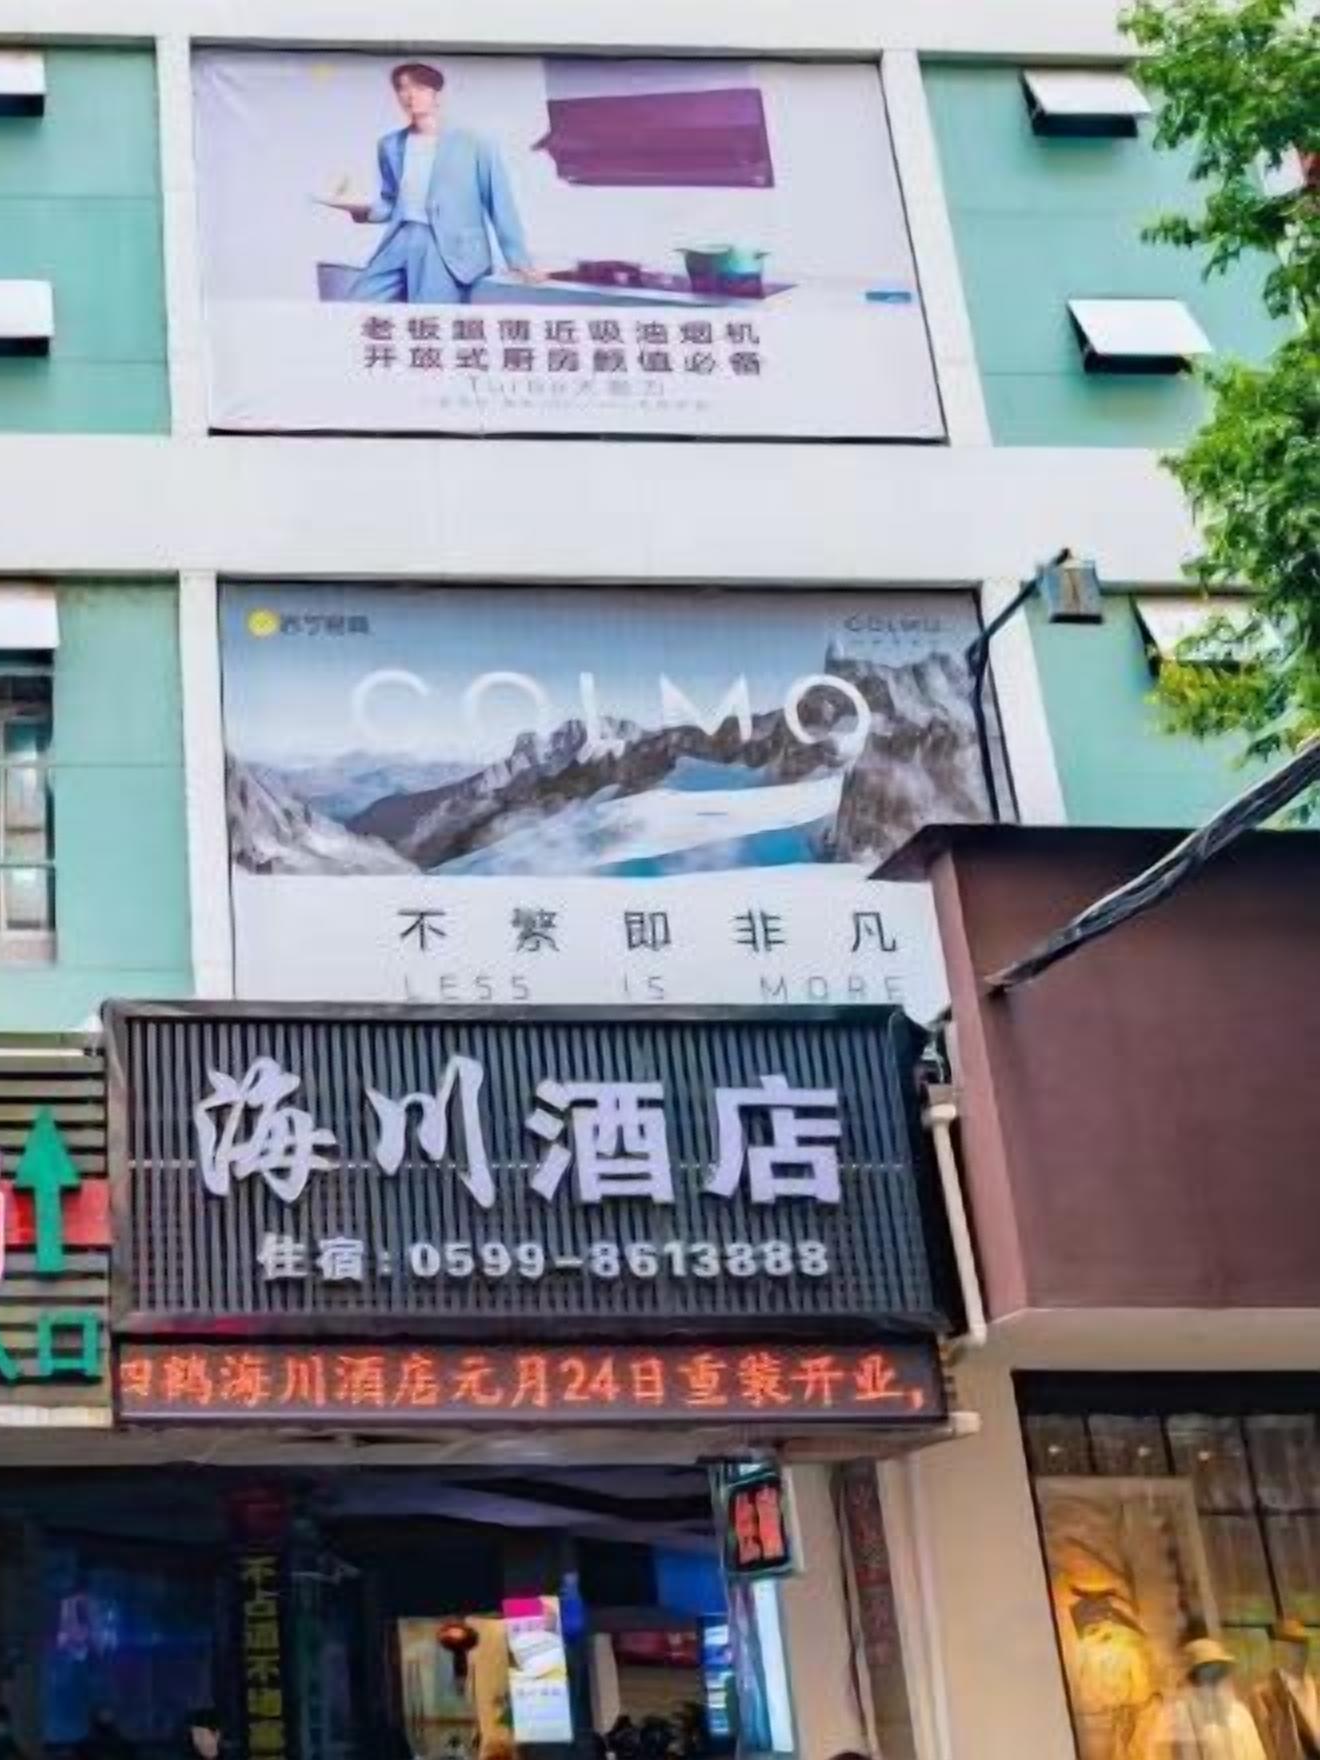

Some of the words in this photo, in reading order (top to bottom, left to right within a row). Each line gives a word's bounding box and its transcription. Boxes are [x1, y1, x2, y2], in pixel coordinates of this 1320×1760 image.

[397, 908, 897, 953] 不繁即非凡
[403, 974, 530, 1001] LESS
[622, 975, 667, 1001] IS
[759, 974, 907, 1001] MORE
[194, 1055, 843, 1207] 海川酒店
